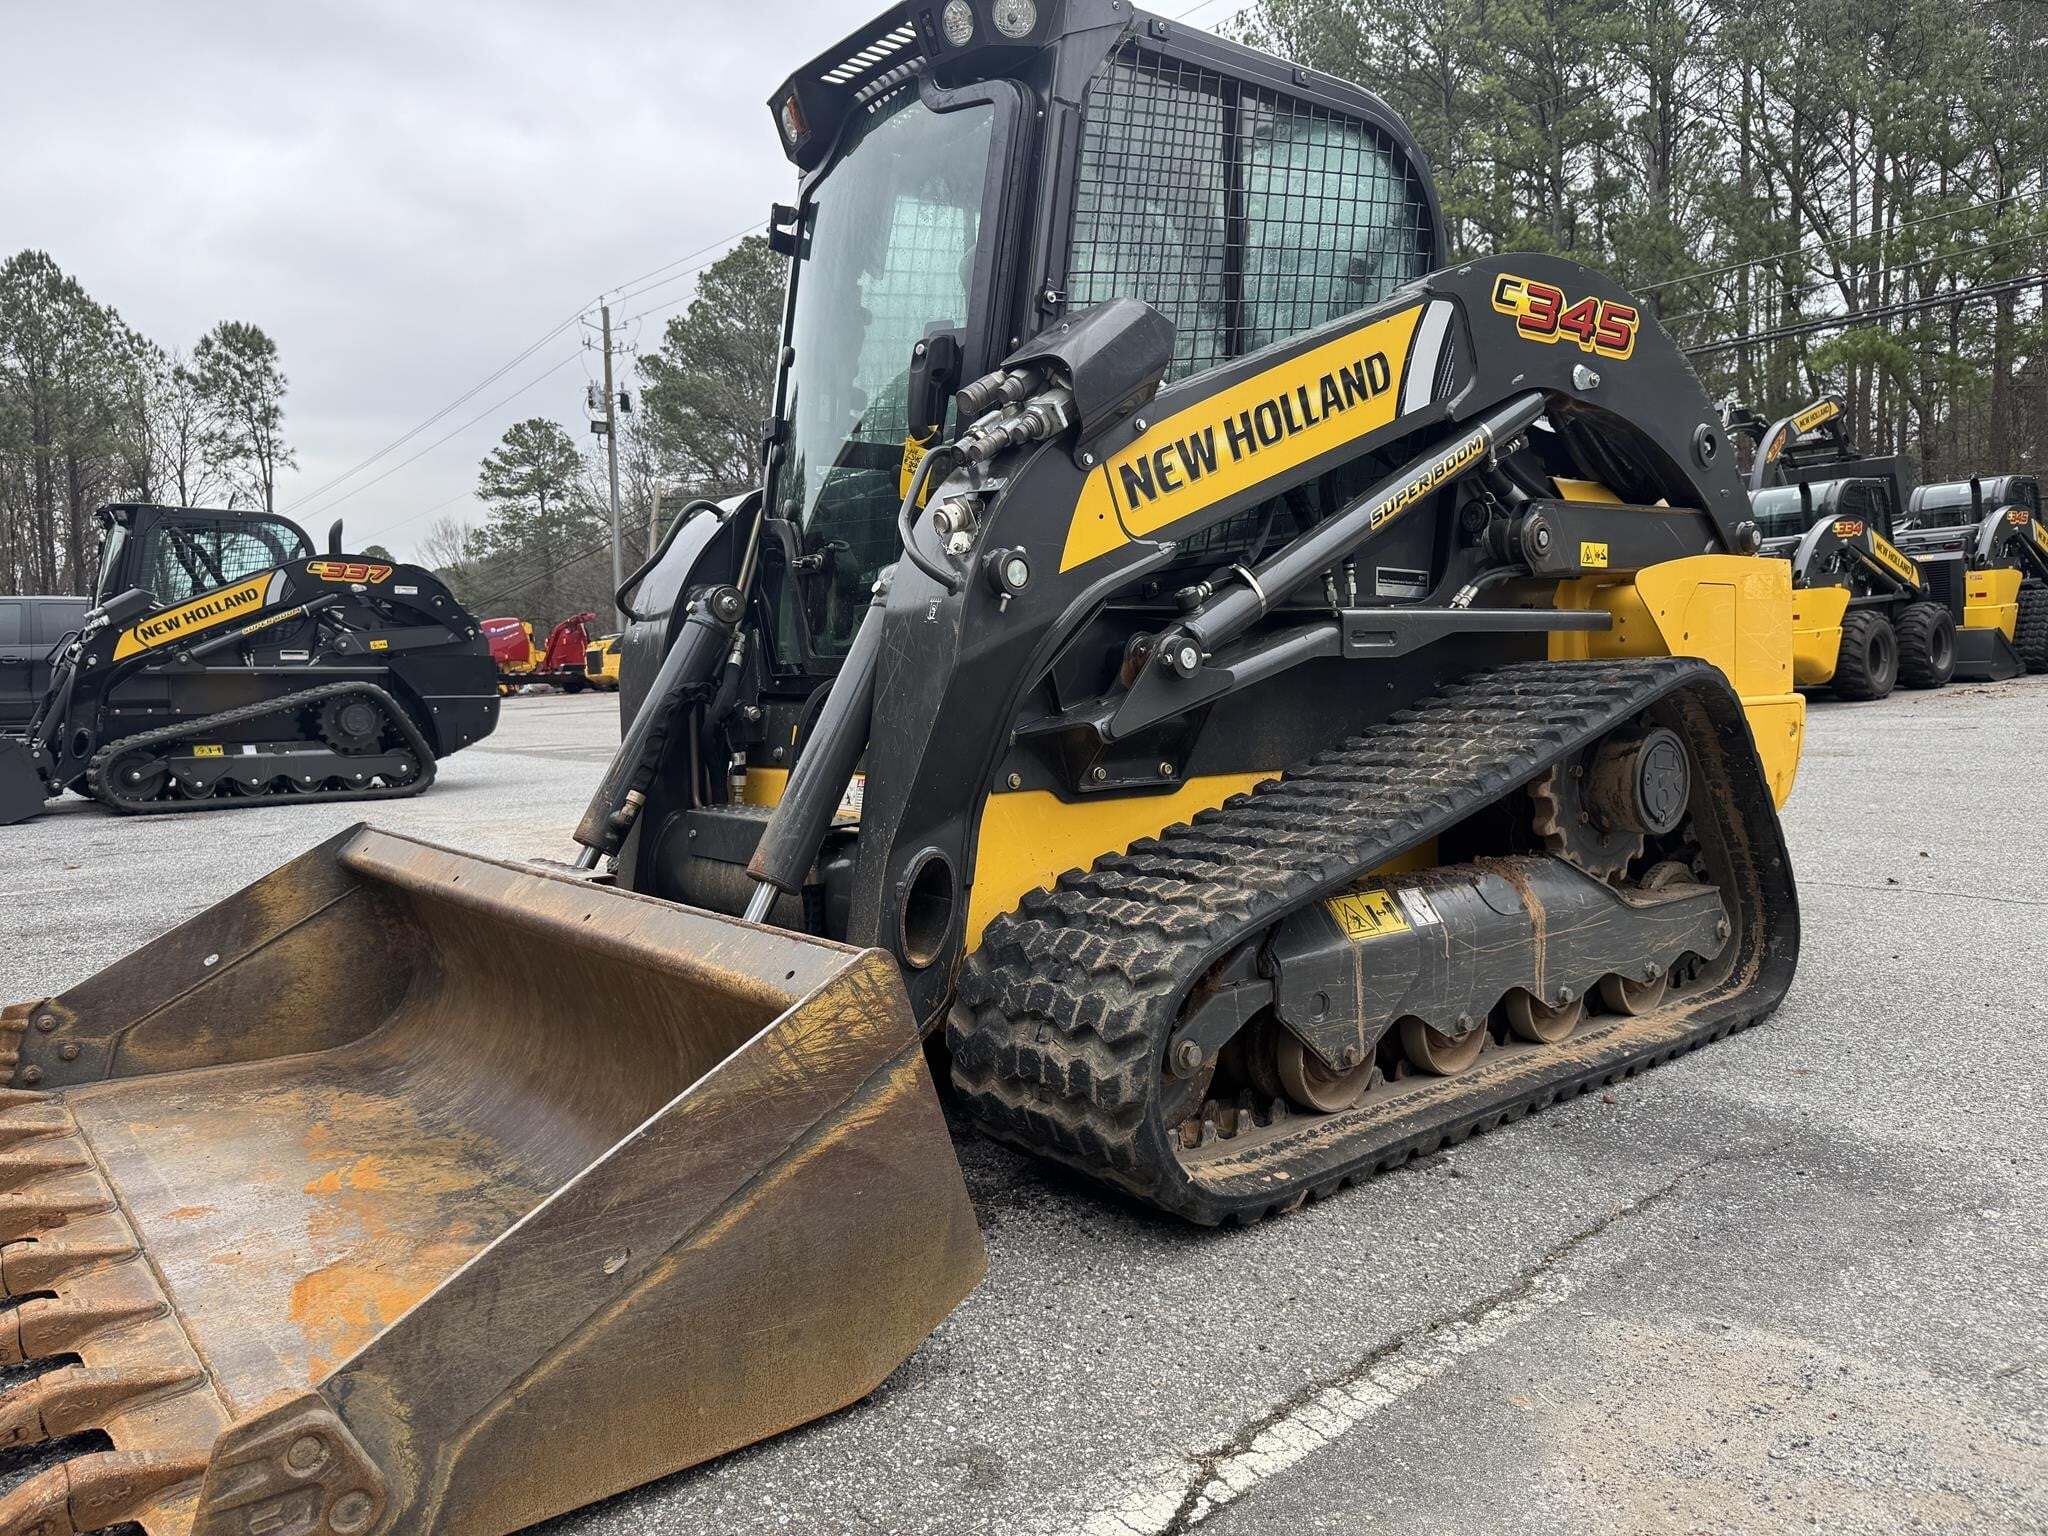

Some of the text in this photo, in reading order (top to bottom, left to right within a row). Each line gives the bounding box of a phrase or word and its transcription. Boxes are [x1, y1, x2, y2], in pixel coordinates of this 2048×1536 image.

[1493, 275, 1638, 358] C345
[1119, 351, 1392, 510] NEW HOLLAND
[1370, 434, 1484, 530] SUPER BOOM
[307, 561, 393, 583] C337
[1876, 541, 1888, 557] NEW
[1887, 550, 1912, 575] HOLLAND
[140, 587, 259, 641] NEW HOLLAND
